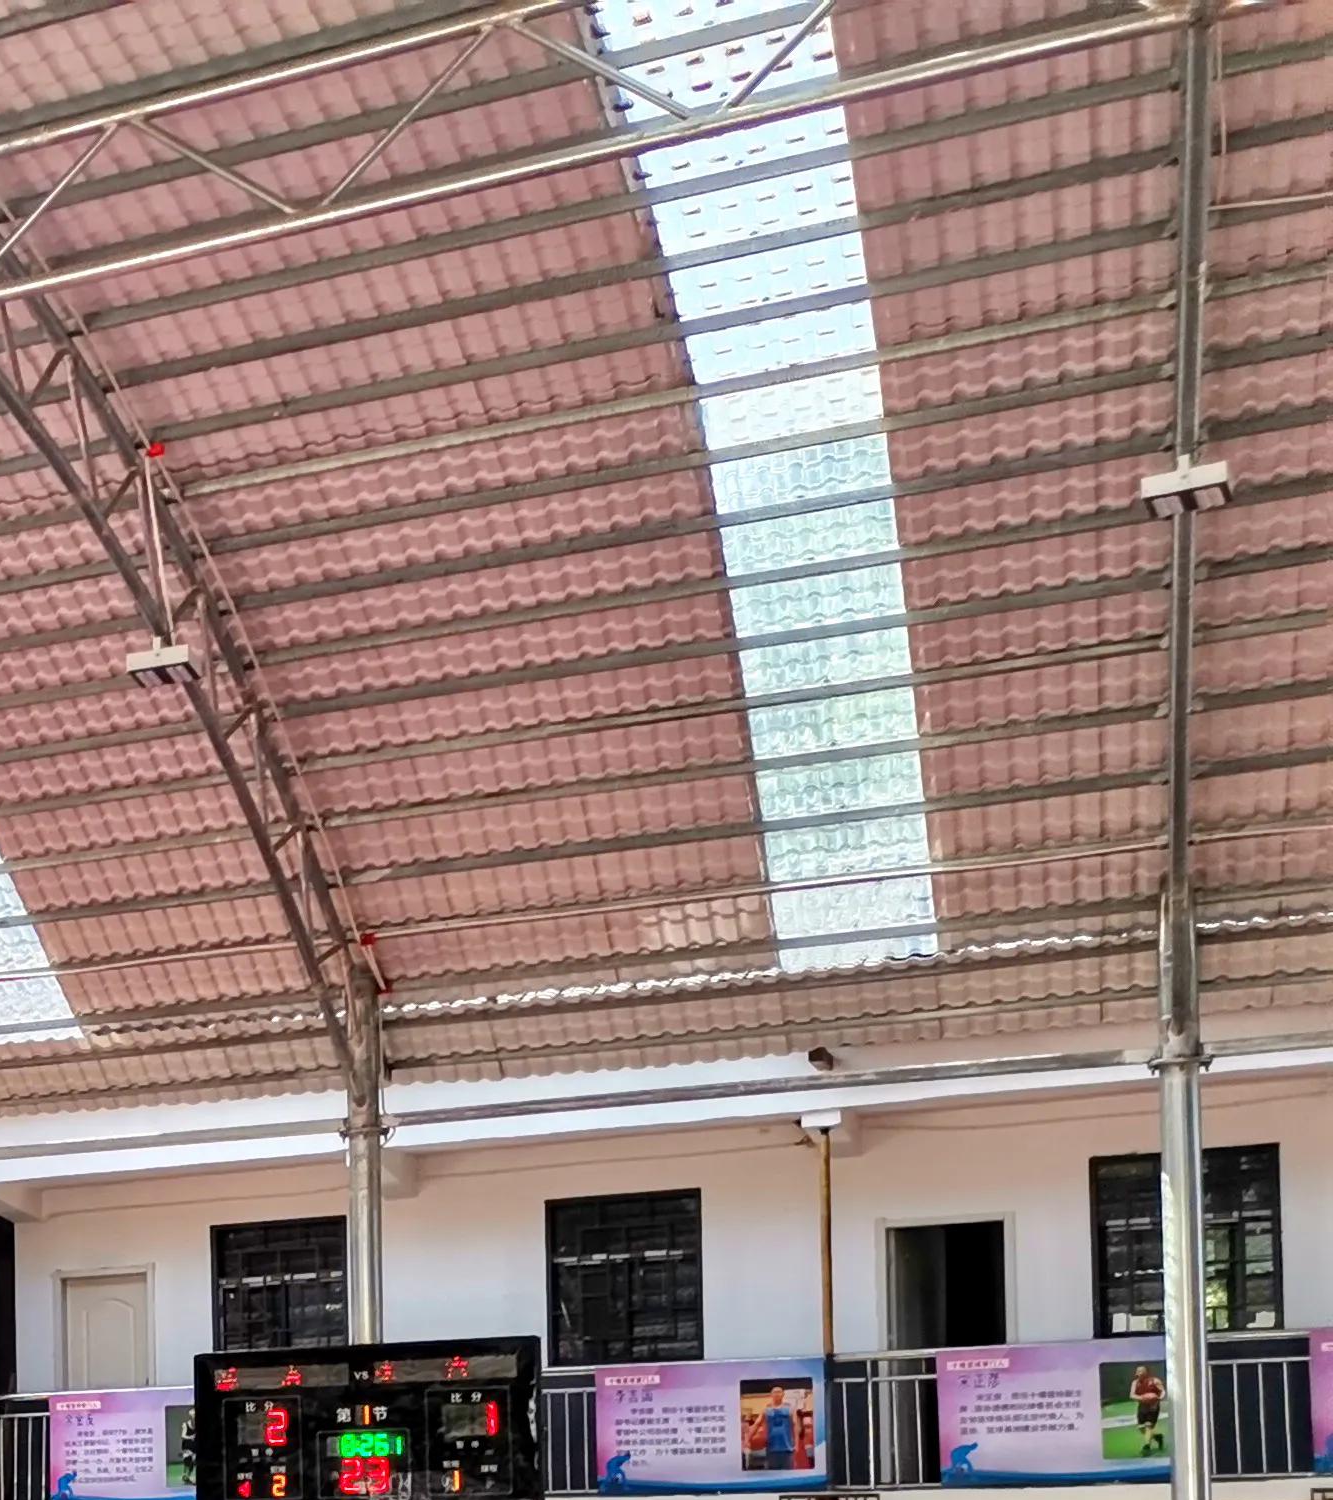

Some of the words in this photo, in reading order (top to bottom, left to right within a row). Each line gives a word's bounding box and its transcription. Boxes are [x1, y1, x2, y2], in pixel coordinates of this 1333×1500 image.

[264, 1408, 289, 1447] 2
[271, 1474, 286, 1497] 2
[341, 1456, 390, 1494] 23
